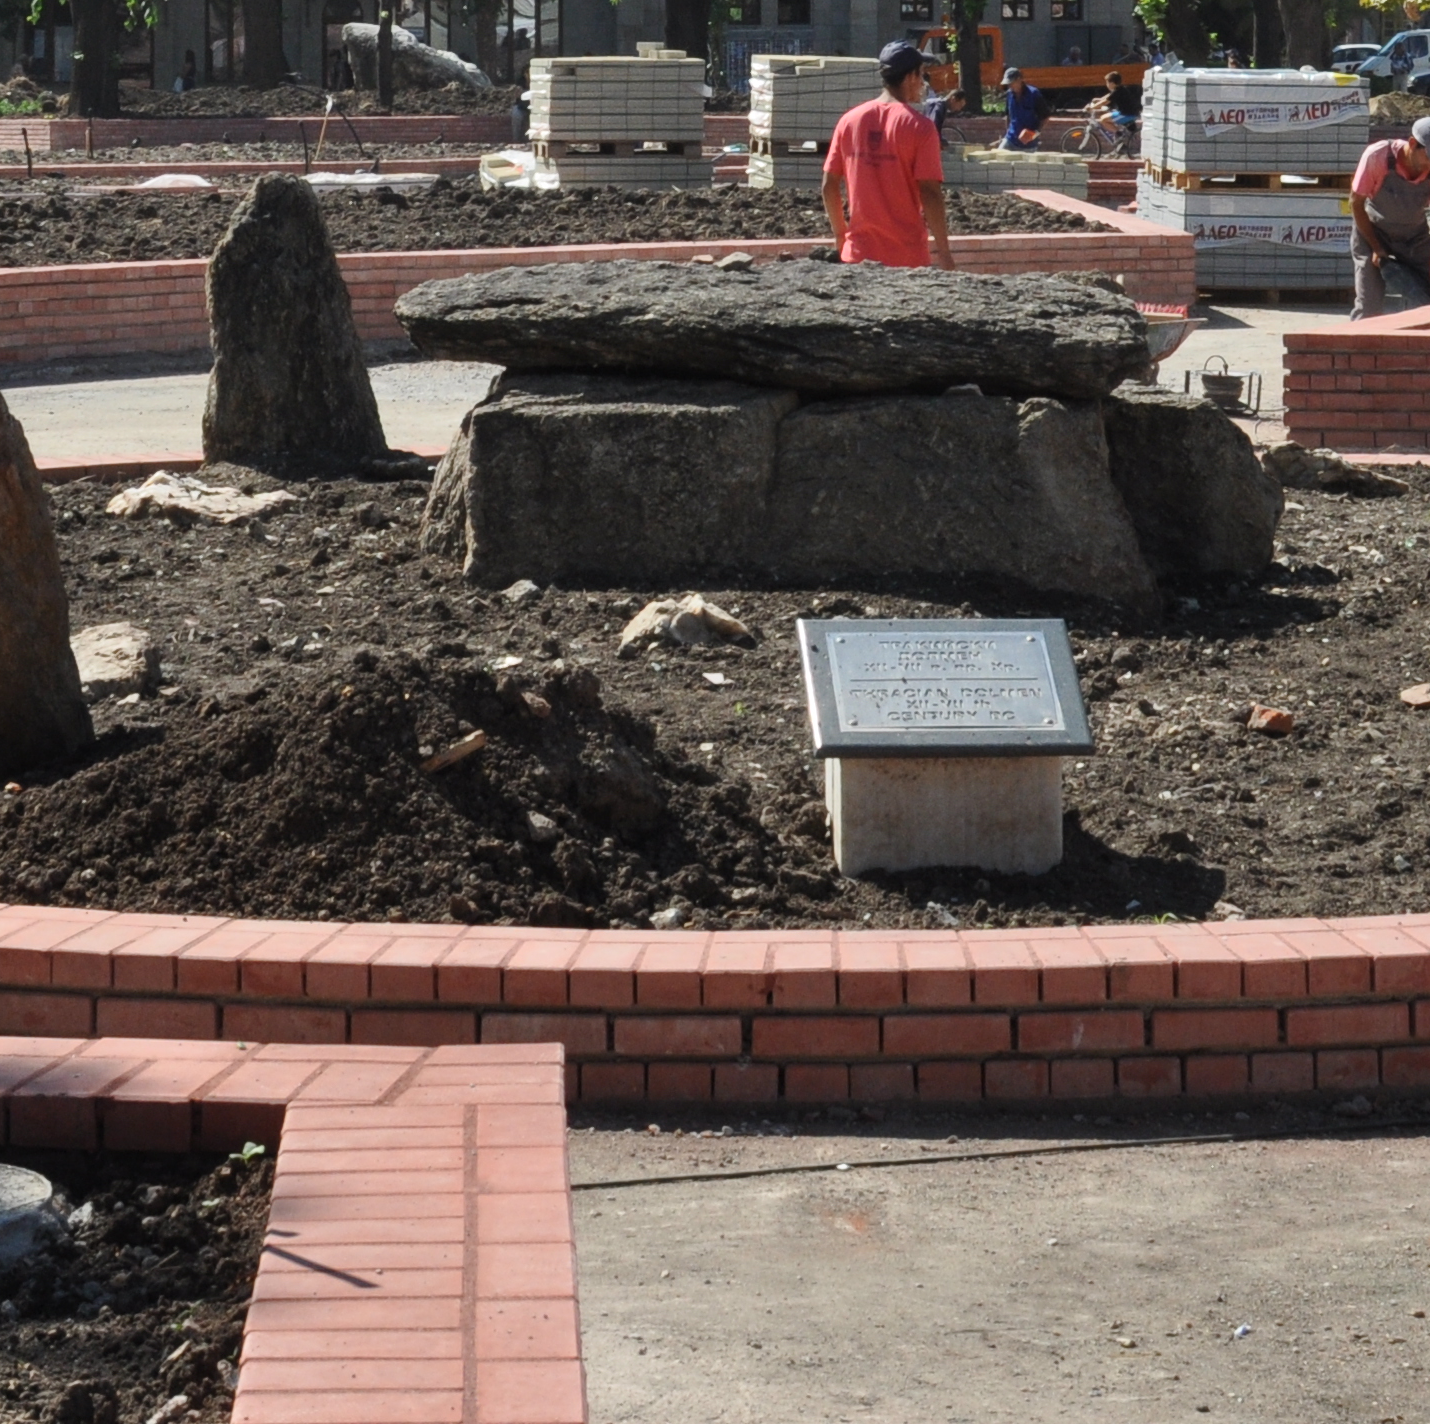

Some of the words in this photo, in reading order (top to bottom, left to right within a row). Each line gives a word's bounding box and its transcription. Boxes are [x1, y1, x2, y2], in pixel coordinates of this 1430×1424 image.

[878, 639, 997, 650] ТРАКИЙСКИ
[898, 651, 982, 662] ДОЛМЕН
[954, 664, 982, 672] пр.
[849, 688, 950, 699] THRACIAN
[960, 688, 1042, 698] DOLMEN
[973, 699, 991, 708] th
[887, 711, 978, 721] CENTURY
[989, 711, 1016, 721] BC
